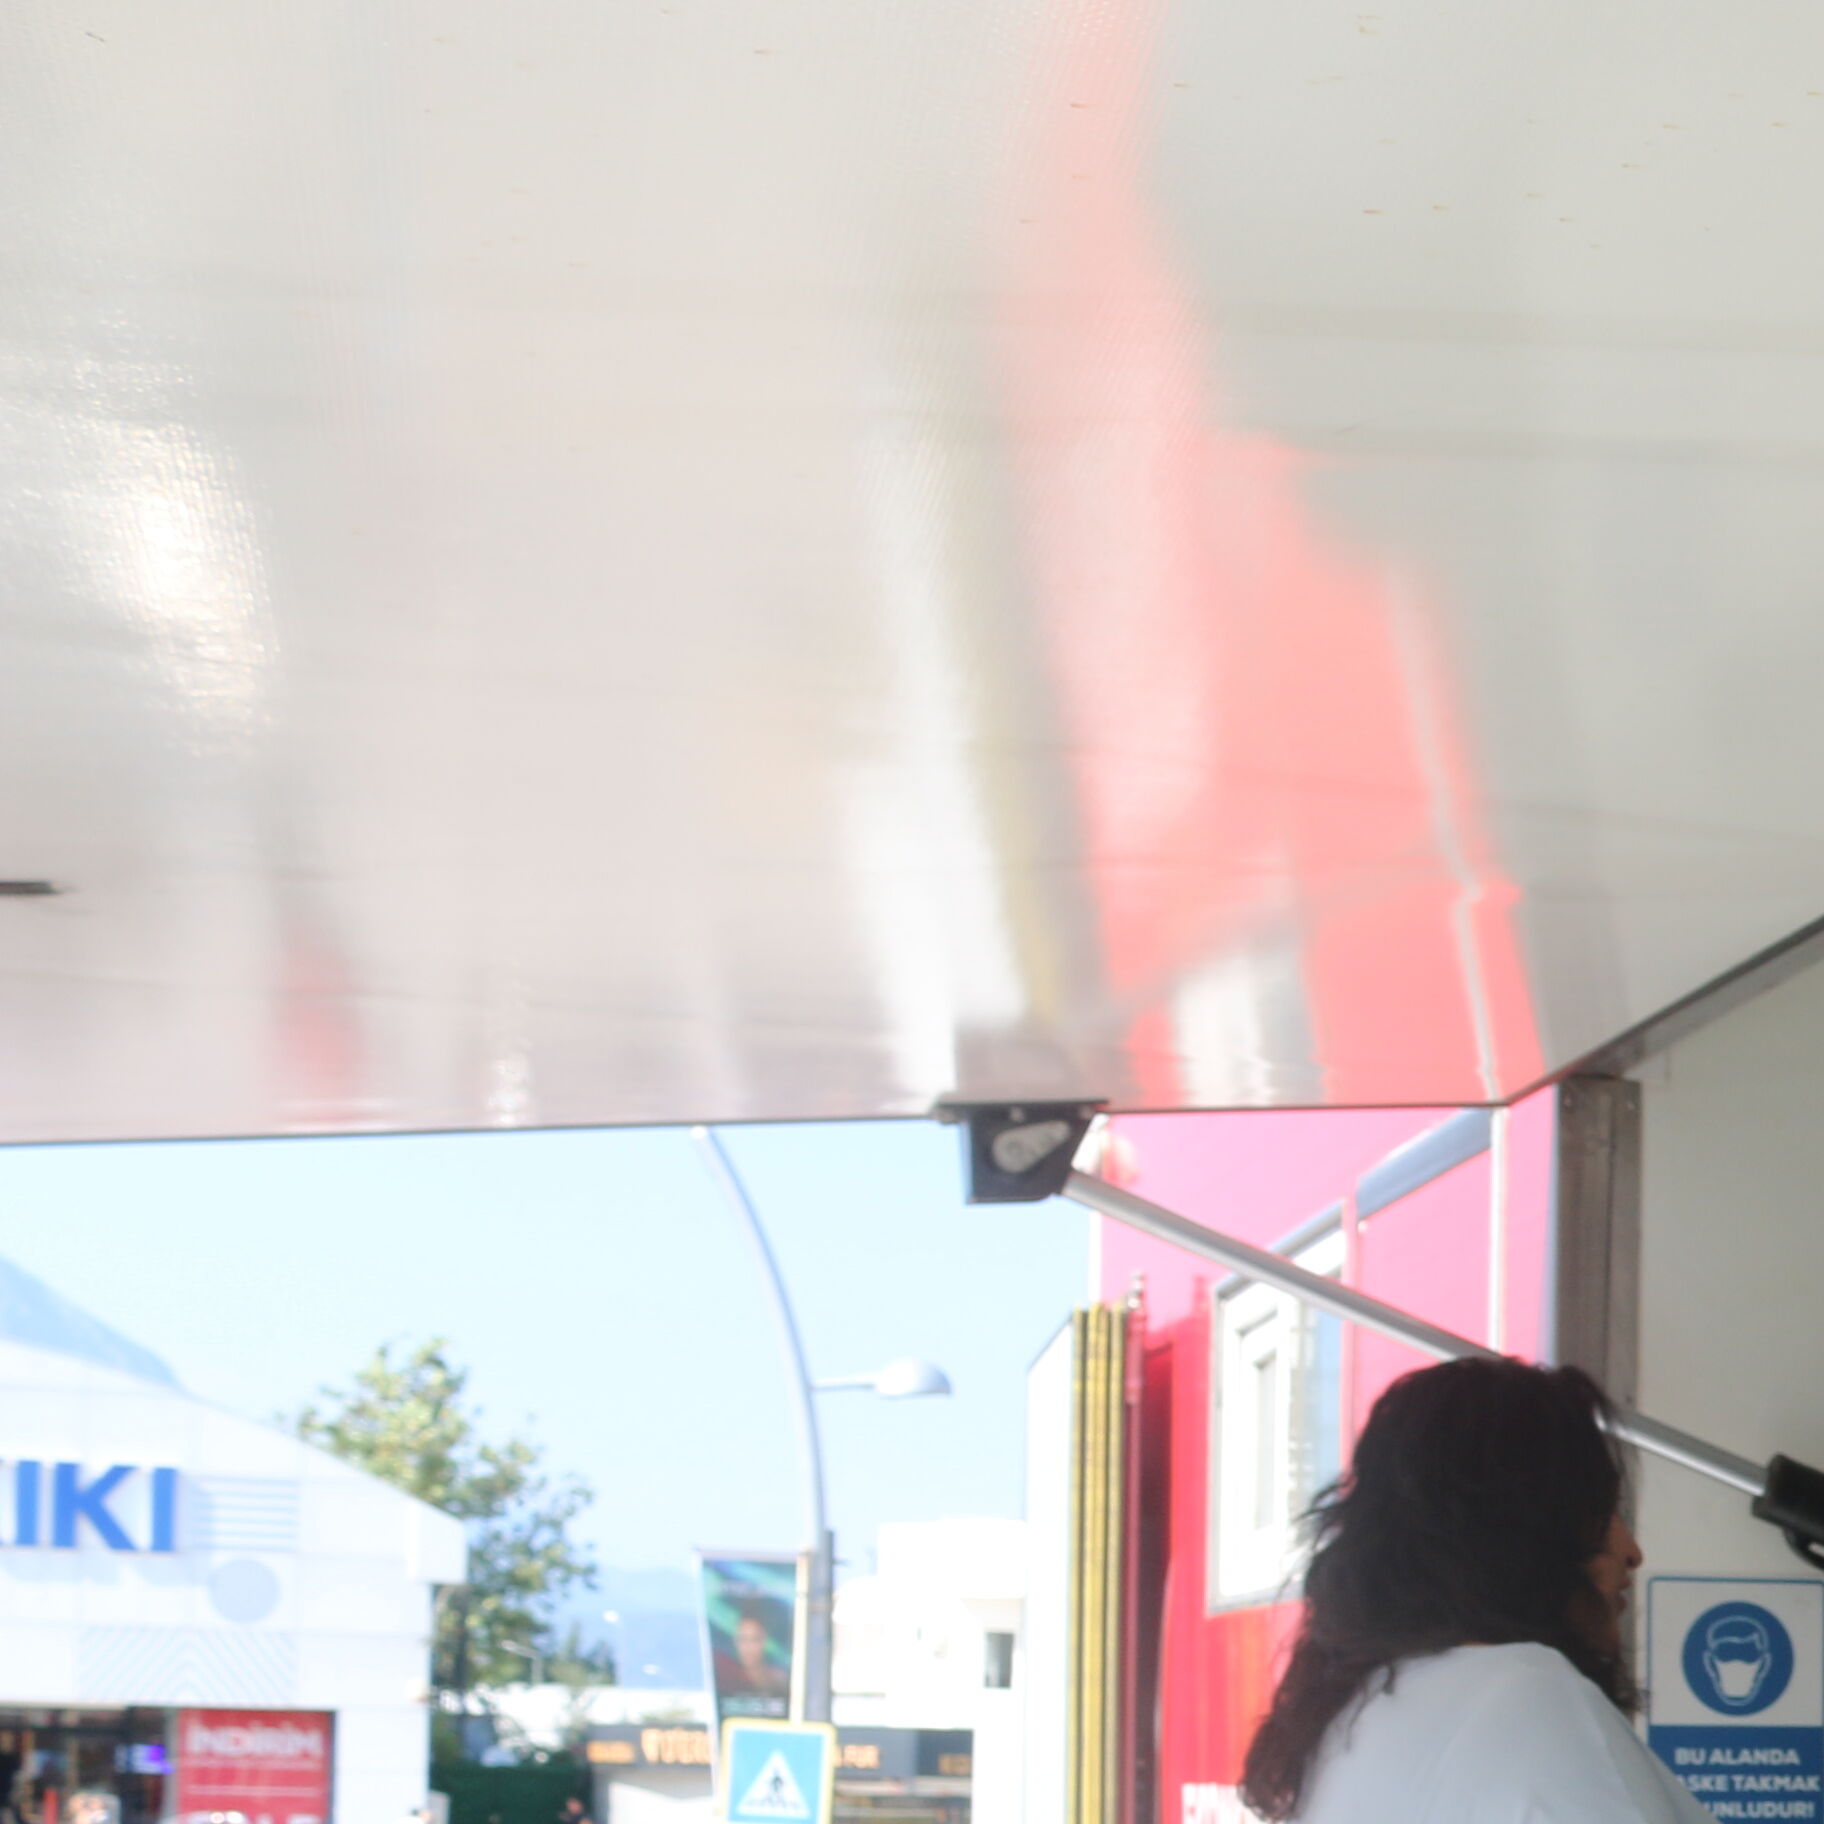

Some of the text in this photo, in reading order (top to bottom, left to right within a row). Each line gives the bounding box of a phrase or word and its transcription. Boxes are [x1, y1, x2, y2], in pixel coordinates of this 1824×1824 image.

[0, 1459, 179, 1553] IKI
[1674, 1748, 1800, 1766] BU ALANDA
[1732, 1774, 1821, 1792] TAKMAK
